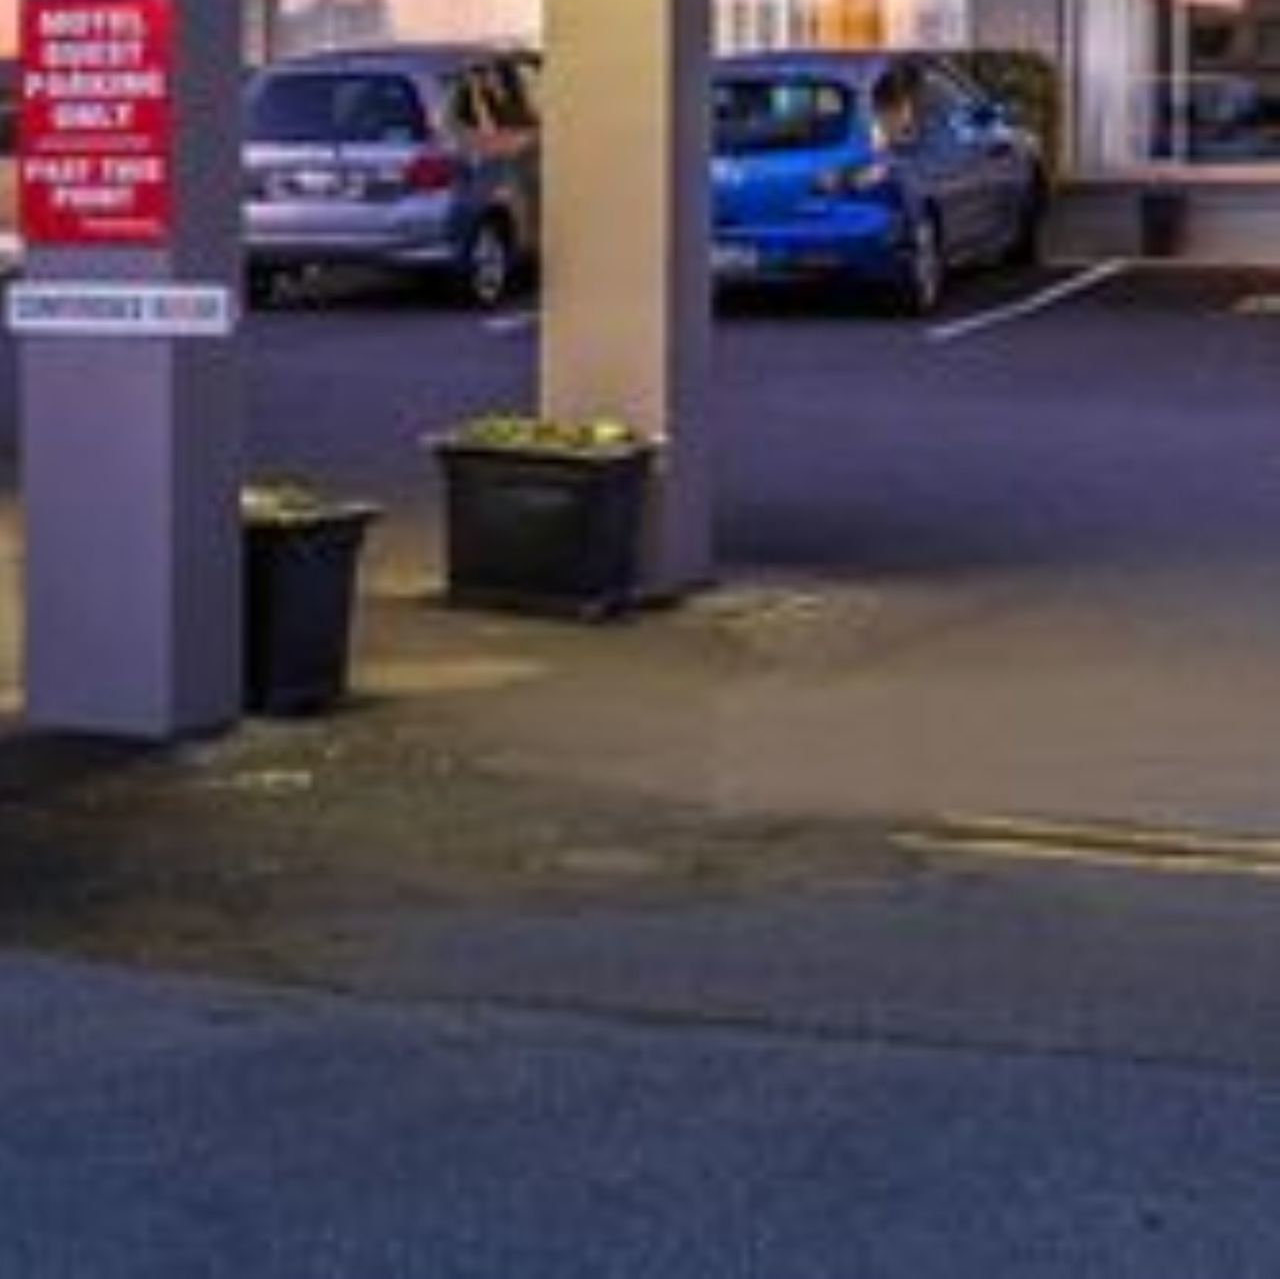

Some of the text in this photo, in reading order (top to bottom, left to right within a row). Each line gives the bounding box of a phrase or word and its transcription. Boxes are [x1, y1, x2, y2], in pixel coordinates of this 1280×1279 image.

[40, 8, 148, 39] MOTEL
[43, 39, 144, 68] GUEST
[23, 69, 167, 99] PARKING
[53, 101, 135, 129] ONLY
